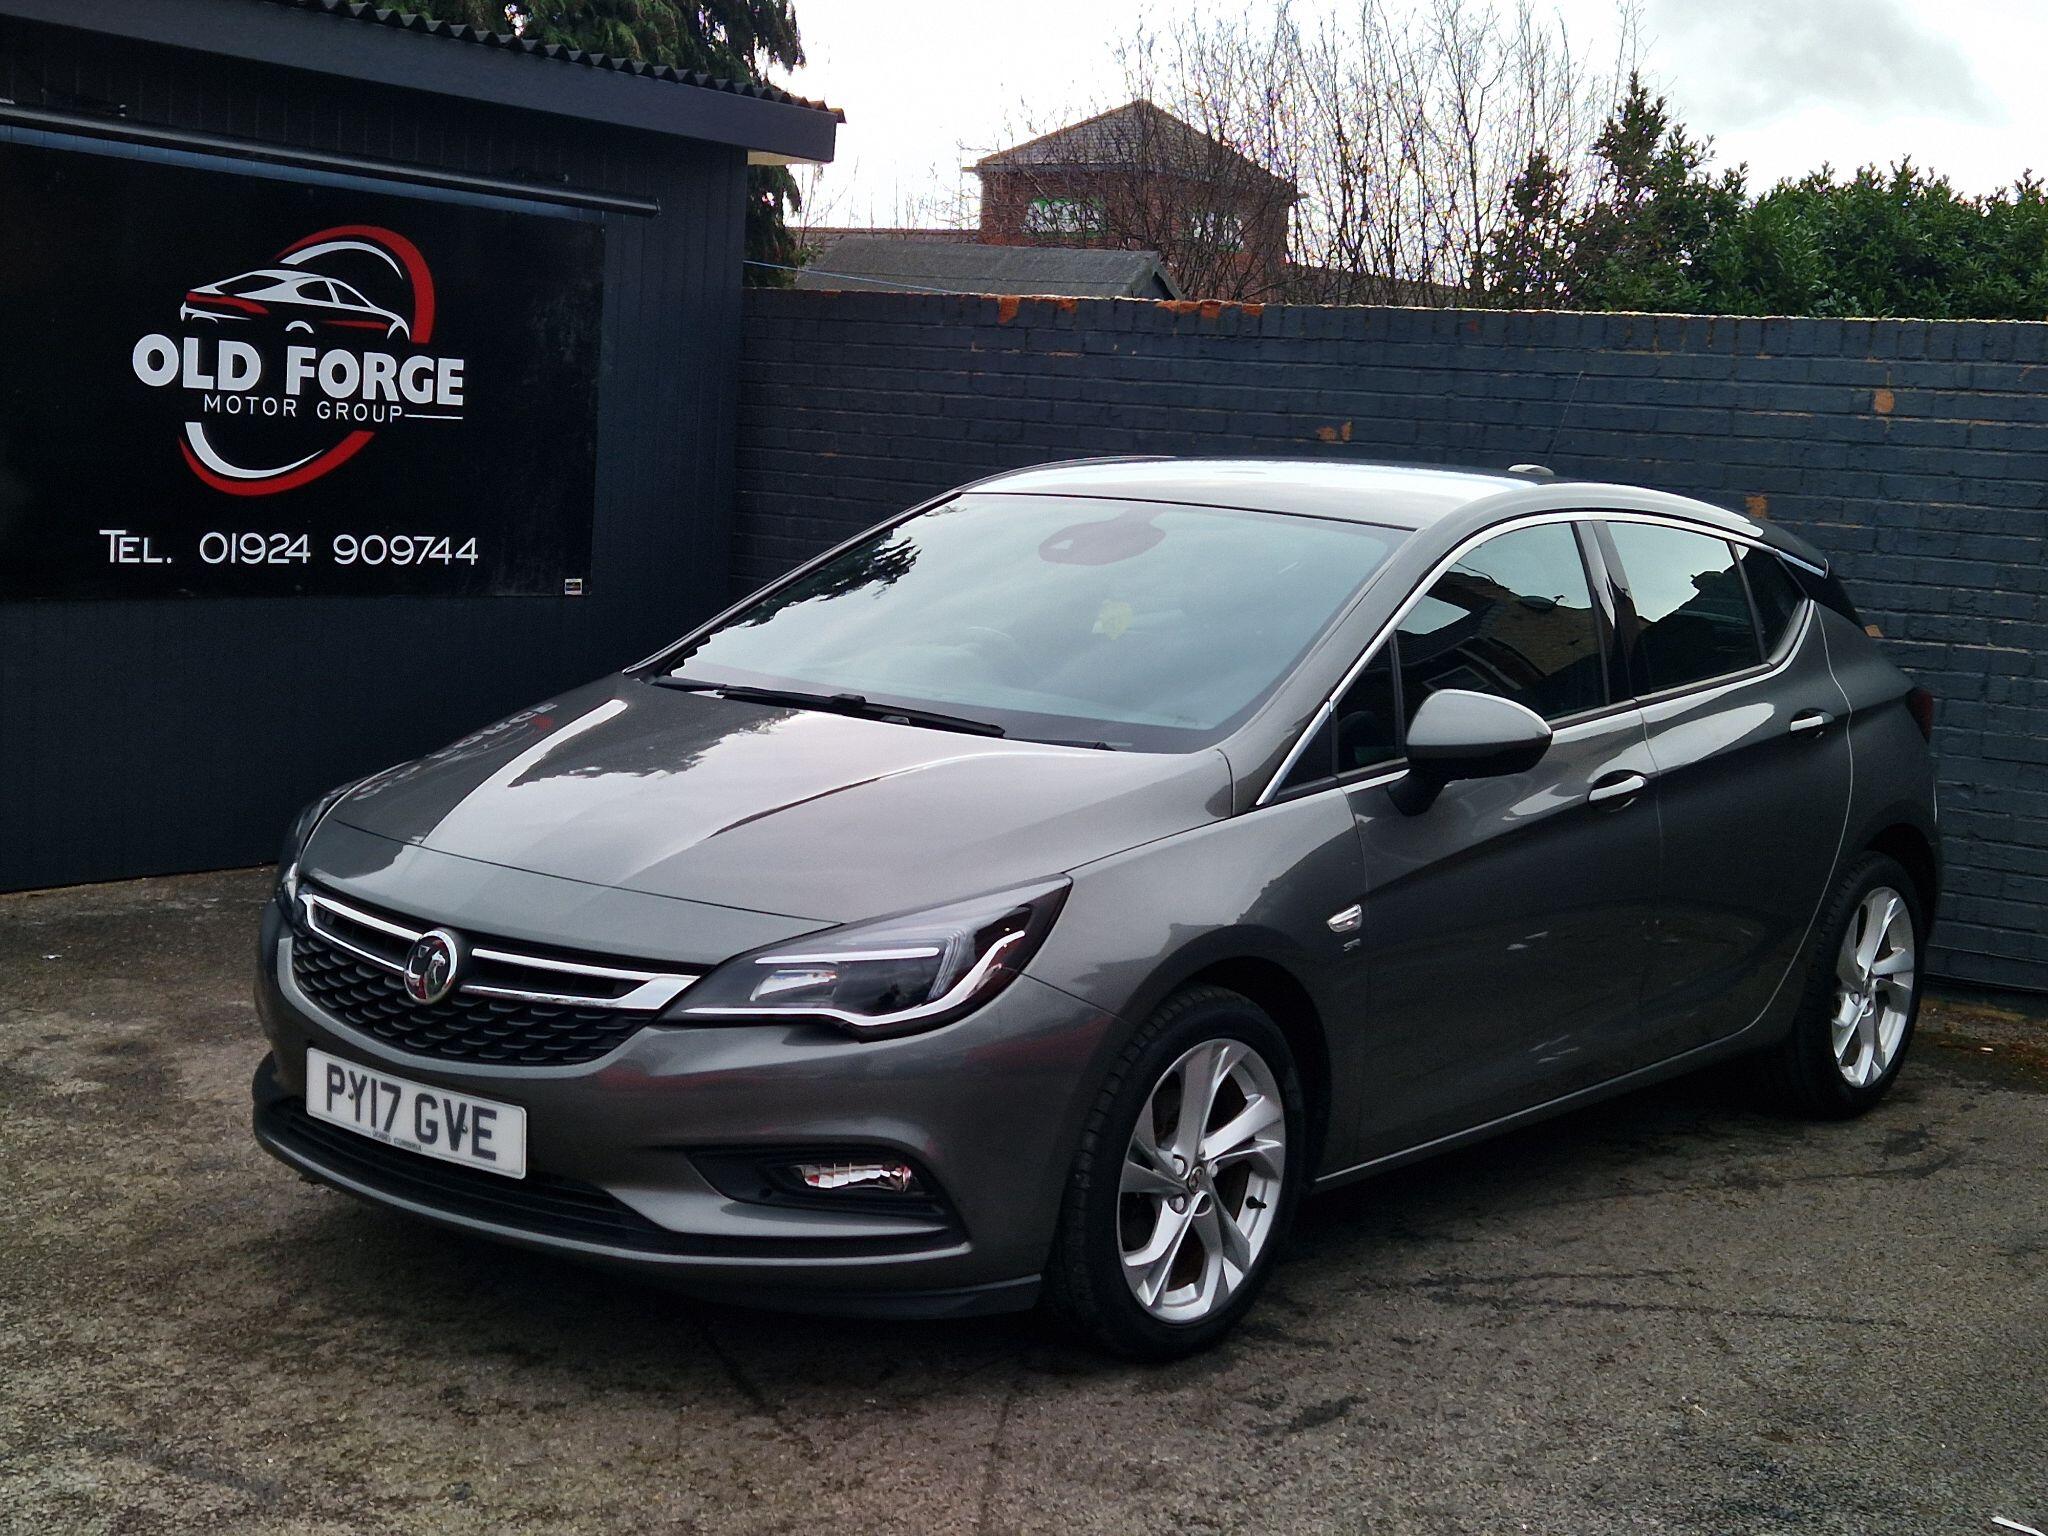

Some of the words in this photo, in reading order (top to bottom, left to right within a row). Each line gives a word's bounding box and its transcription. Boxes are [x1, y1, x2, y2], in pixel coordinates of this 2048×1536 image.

[132, 333, 262, 391] OLD
[286, 345, 464, 406] FORGE
[203, 394, 297, 417] MOTOR
[316, 402, 403, 424] GROUP
[99, 529, 173, 565] TEL.
[199, 531, 311, 565] 01924
[333, 533, 479, 566] 909744
[326, 1062, 402, 1133] PY17
[414, 1092, 498, 1162] GVE
